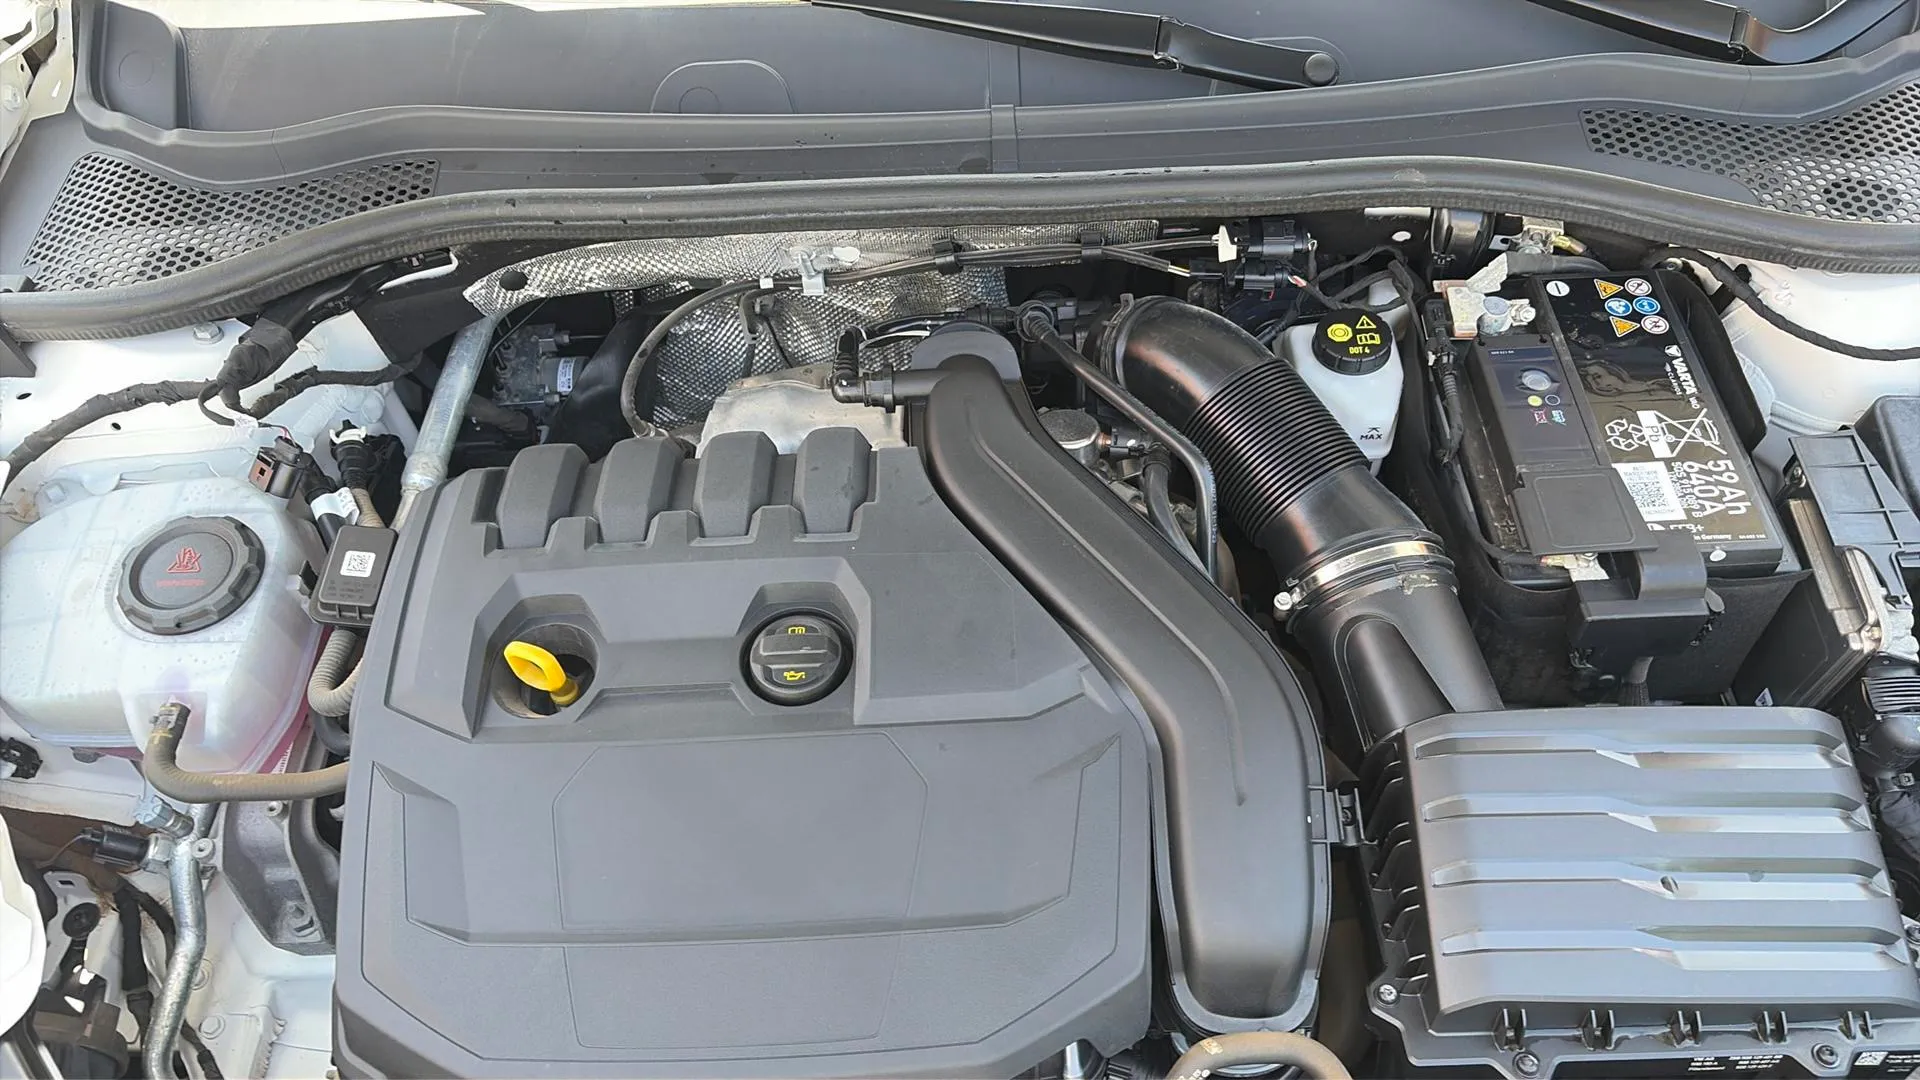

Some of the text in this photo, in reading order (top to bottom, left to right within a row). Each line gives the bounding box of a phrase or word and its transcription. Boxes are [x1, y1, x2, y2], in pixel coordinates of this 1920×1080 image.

[1349, 346, 1370, 354] DOT 4
[1667, 371, 1682, 395] CLARIOS
[1672, 357, 1698, 395] VARTA
[1645, 425, 1660, 442] Pb
[1682, 461, 1726, 516] 640A
[1708, 459, 1751, 515] 59Ah
